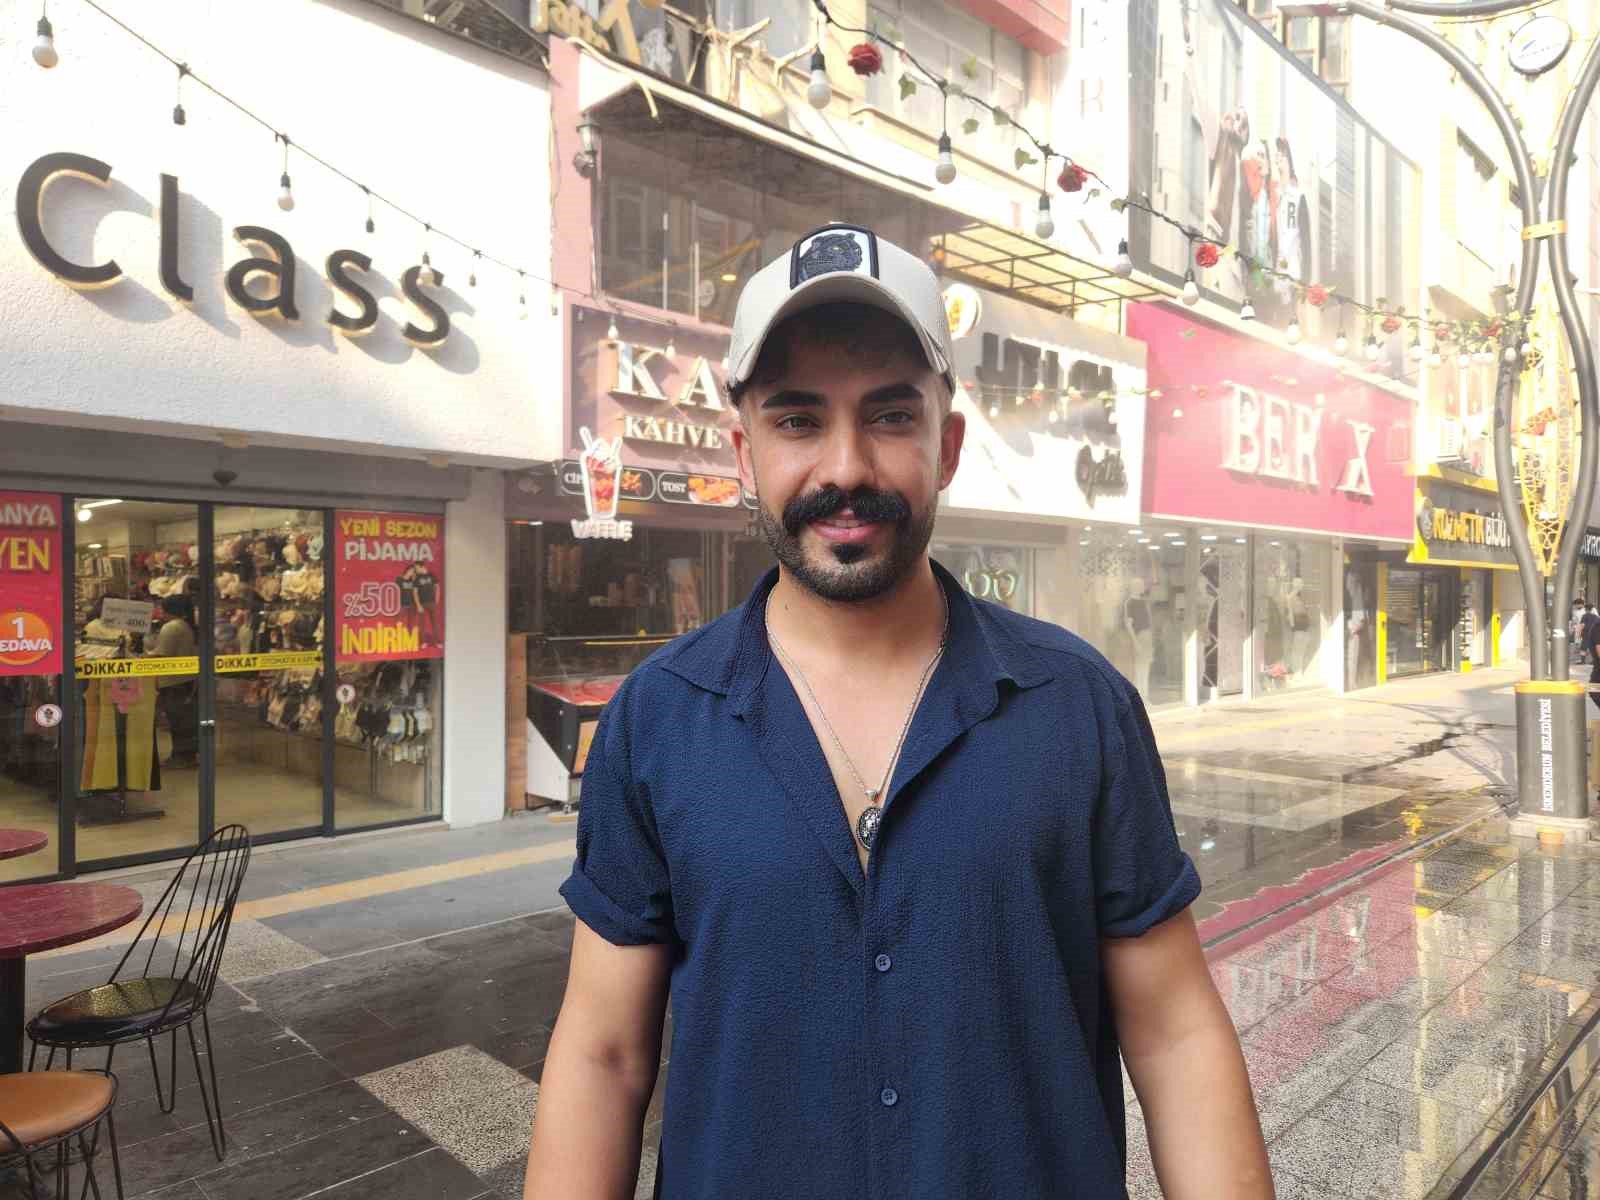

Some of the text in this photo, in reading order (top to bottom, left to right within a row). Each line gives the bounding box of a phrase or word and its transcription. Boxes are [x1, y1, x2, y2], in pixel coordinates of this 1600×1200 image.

[16, 152, 450, 347] Class
[623, 415, 723, 449] KAHVE
[661, 481, 687, 494] TOST
[340, 517, 438, 539] YENİ SEZON
[344, 538, 434, 561] PİJAMA
[343, 582, 401, 617] %50
[11, 617, 24, 638] 1
[341, 620, 419, 655] İNDİRİM
